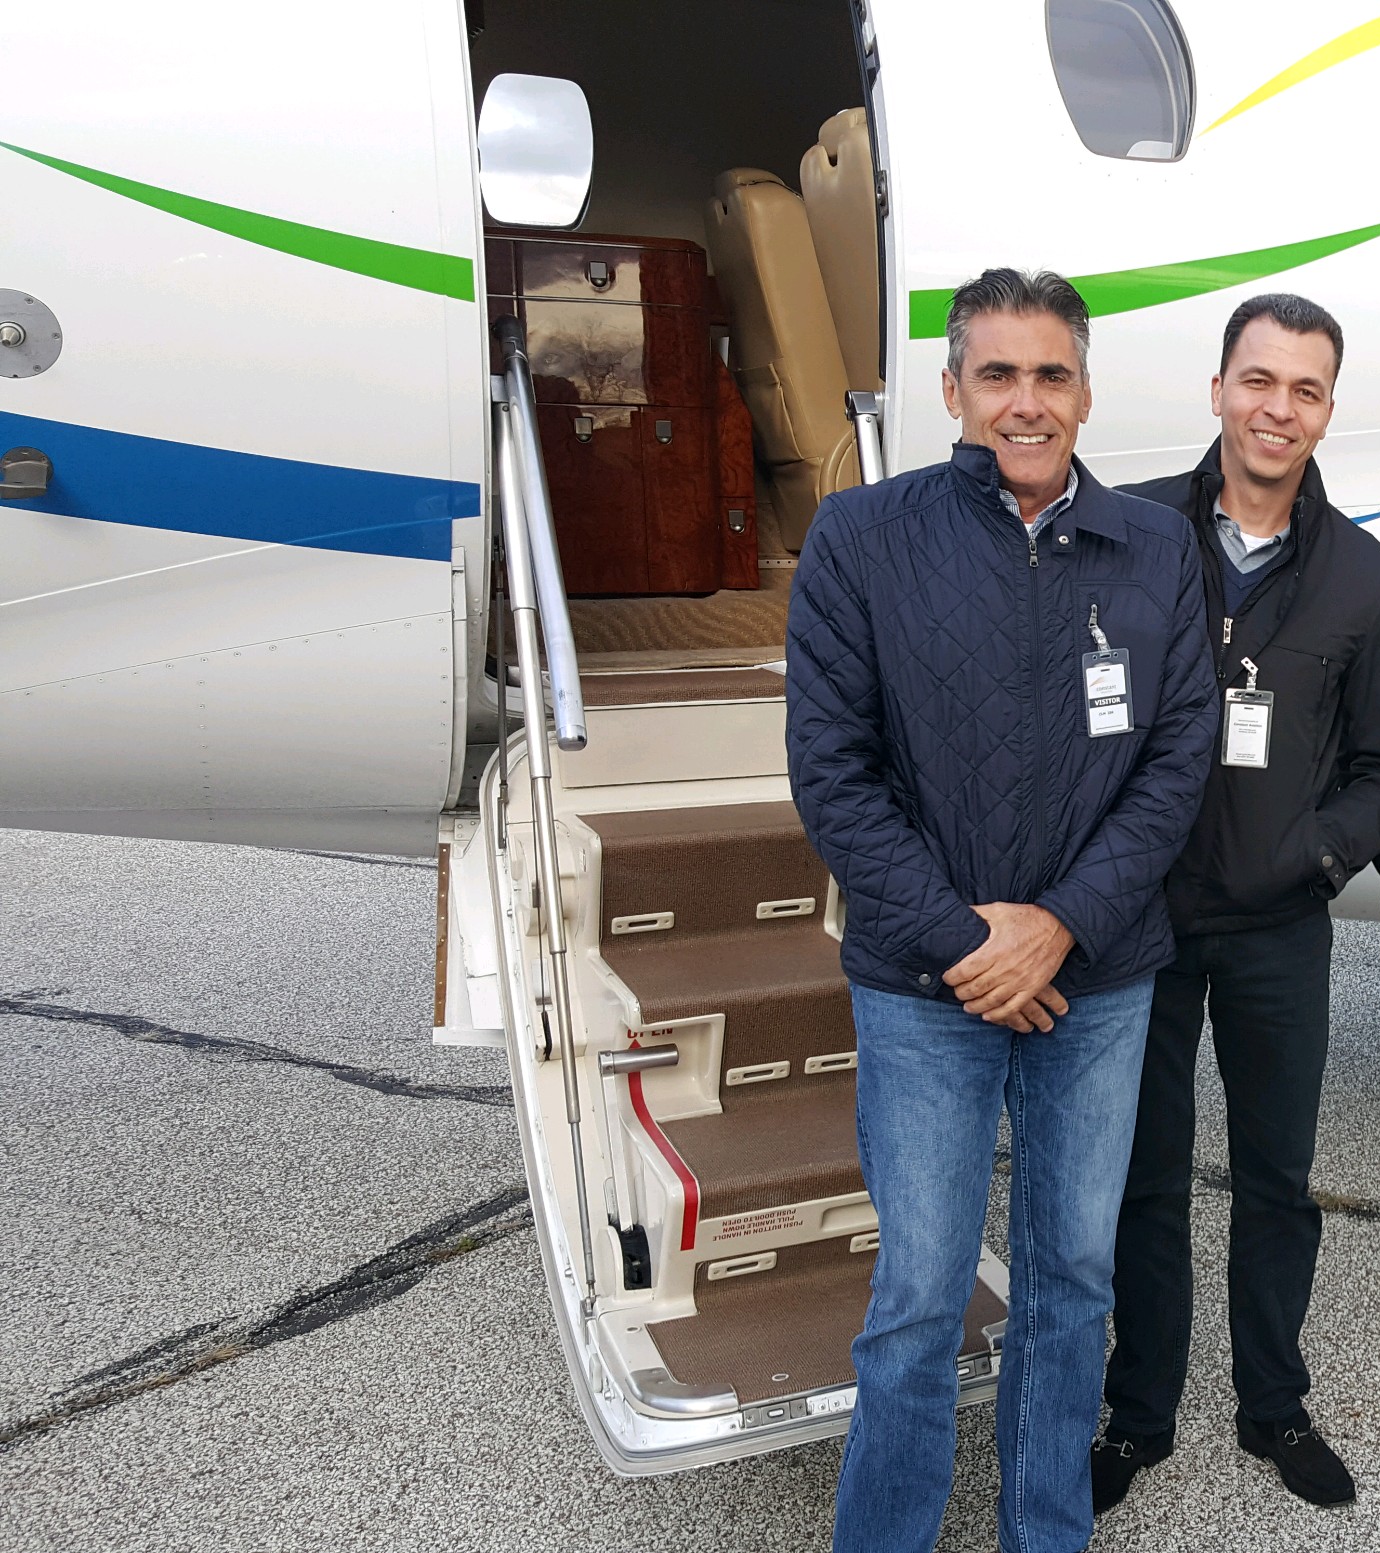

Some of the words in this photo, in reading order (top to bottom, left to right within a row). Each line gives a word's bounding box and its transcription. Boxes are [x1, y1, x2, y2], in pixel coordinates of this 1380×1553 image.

[1095, 697, 1121, 705] VISITOR
[754, 1212, 775, 1221] DOOR
[777, 1208, 797, 1217] PUSH
[722, 1218, 742, 1227] OPEN
[744, 1215, 754, 1223] TO
[747, 1218, 775, 1229] HANDLE
[778, 1215, 795, 1223] PULL
[752, 1223, 782, 1235] BUTTON
[784, 1220, 803, 1229] PUSH
[722, 1225, 745, 1234] DOWN
[743, 1228, 752, 1236] IN
[713, 1231, 742, 1242] HANDLE
